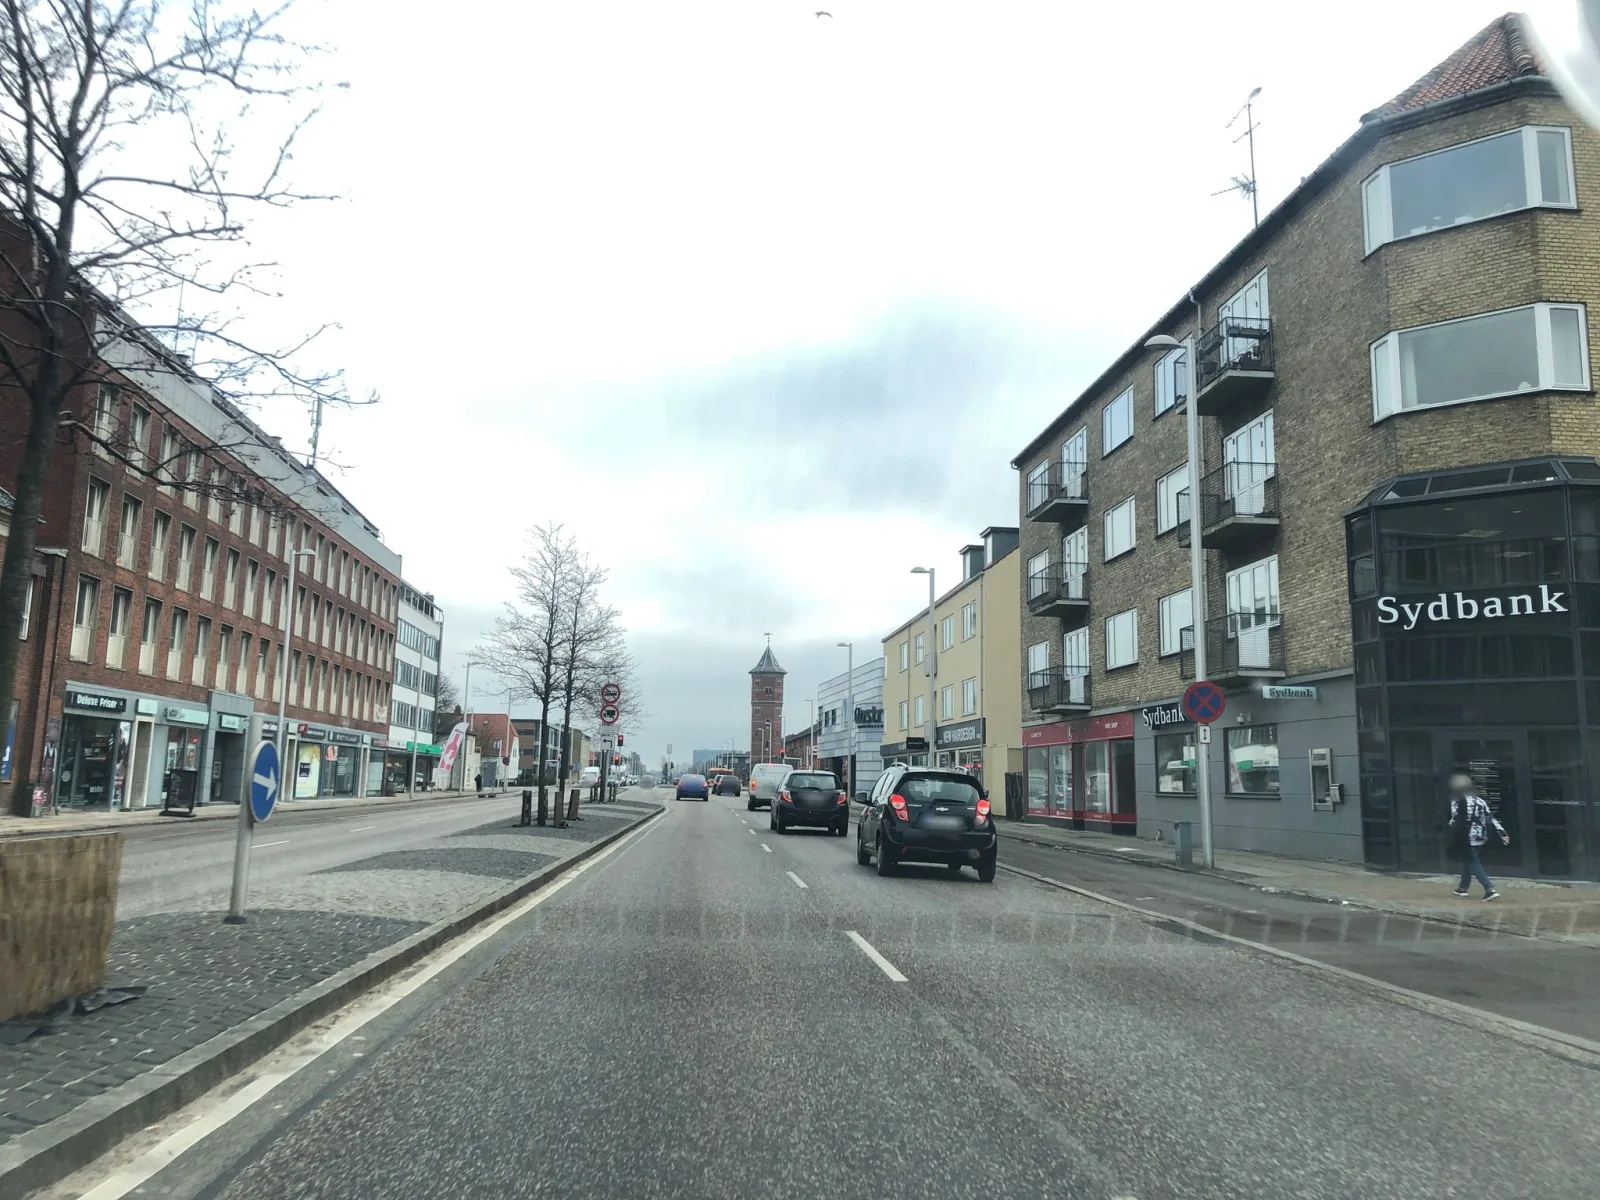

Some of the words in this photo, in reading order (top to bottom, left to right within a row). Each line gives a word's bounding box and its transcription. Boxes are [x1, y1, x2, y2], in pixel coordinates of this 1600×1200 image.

[1377, 585, 1568, 630] Sydbank
[77, 694, 98, 706] Deluxe
[1269, 687, 1313, 698] Sydbank
[1142, 703, 1185, 730] Sydbank
